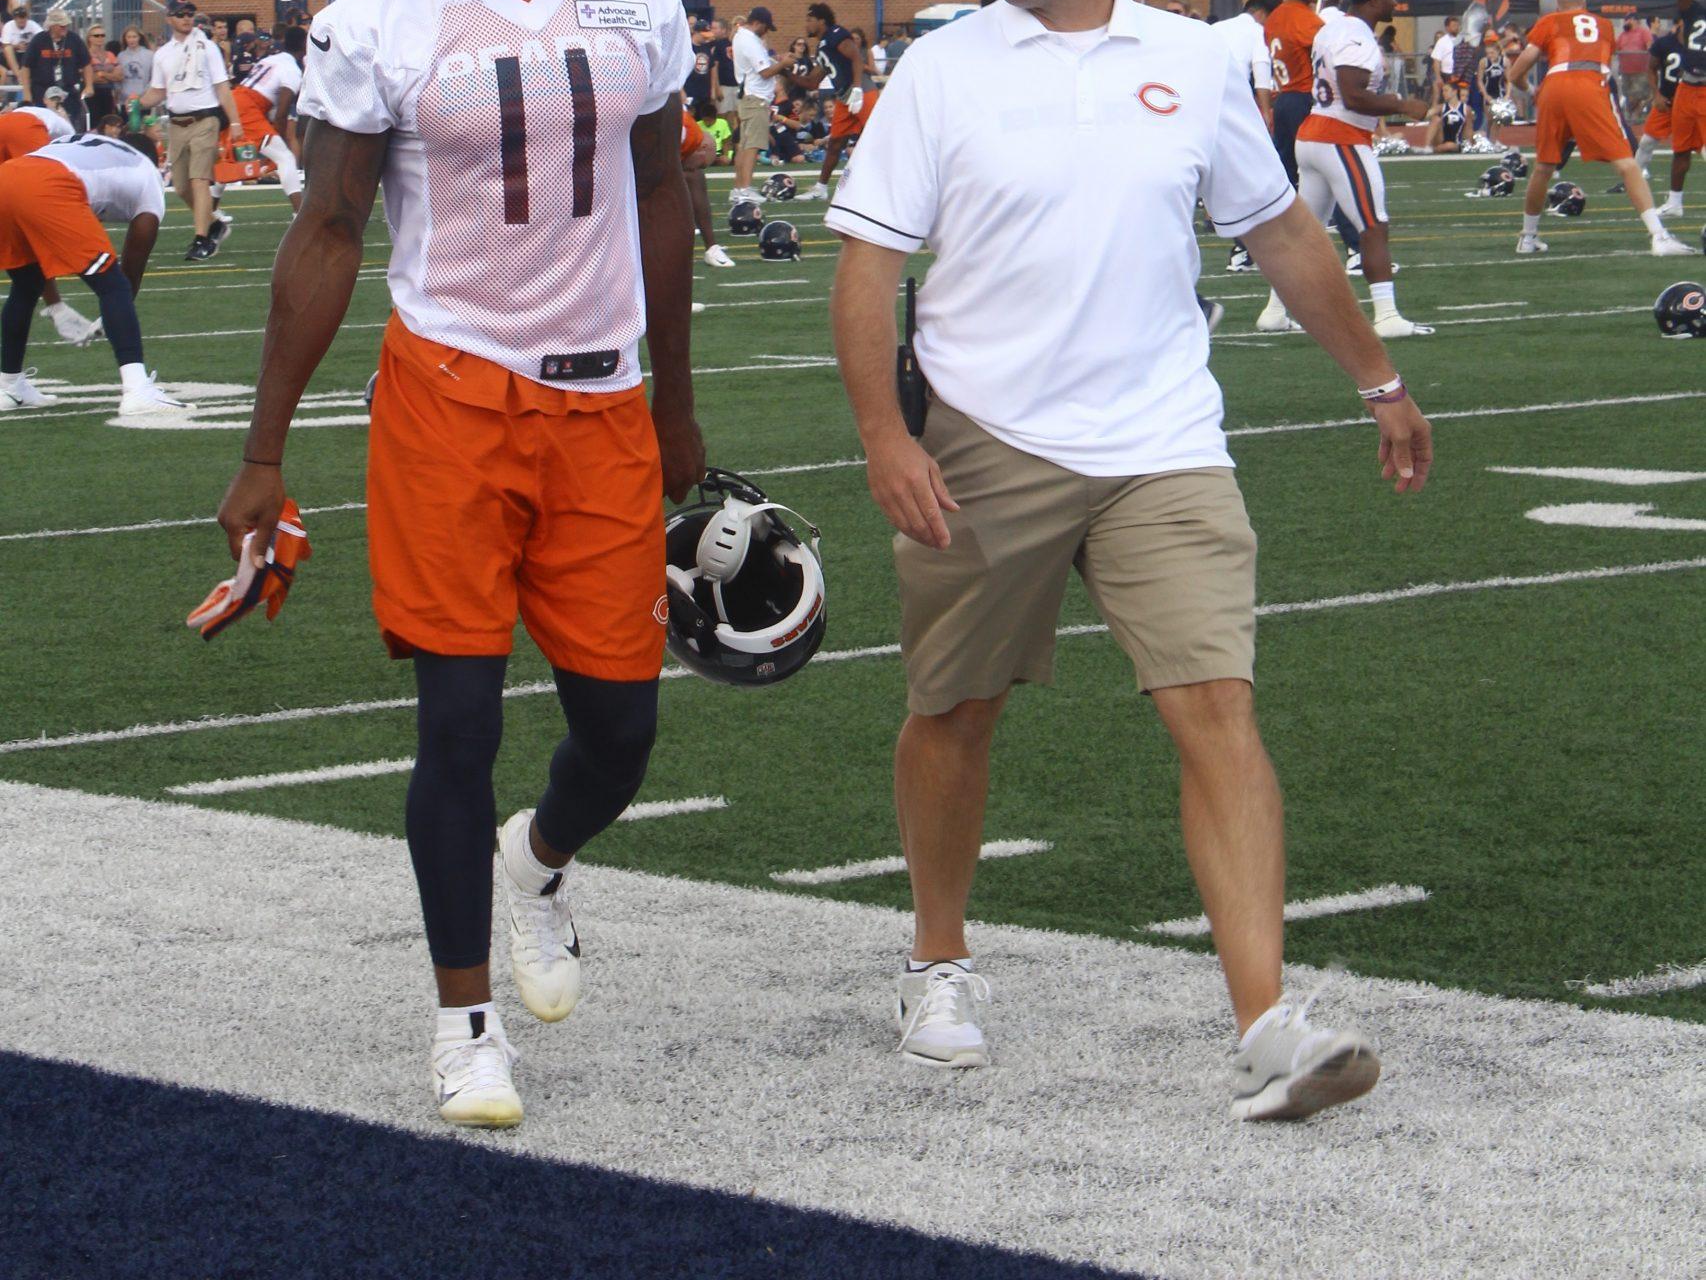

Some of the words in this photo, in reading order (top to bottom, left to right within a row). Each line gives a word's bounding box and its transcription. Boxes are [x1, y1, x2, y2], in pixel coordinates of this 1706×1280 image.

[598, 6, 636, 16] Advocate
[599, 16, 627, 25] Health
[629, 18, 647, 27] Care
[1573, 14, 1599, 43] 8
[1133, 82, 1181, 116] C
[496, 48, 597, 224] 11
